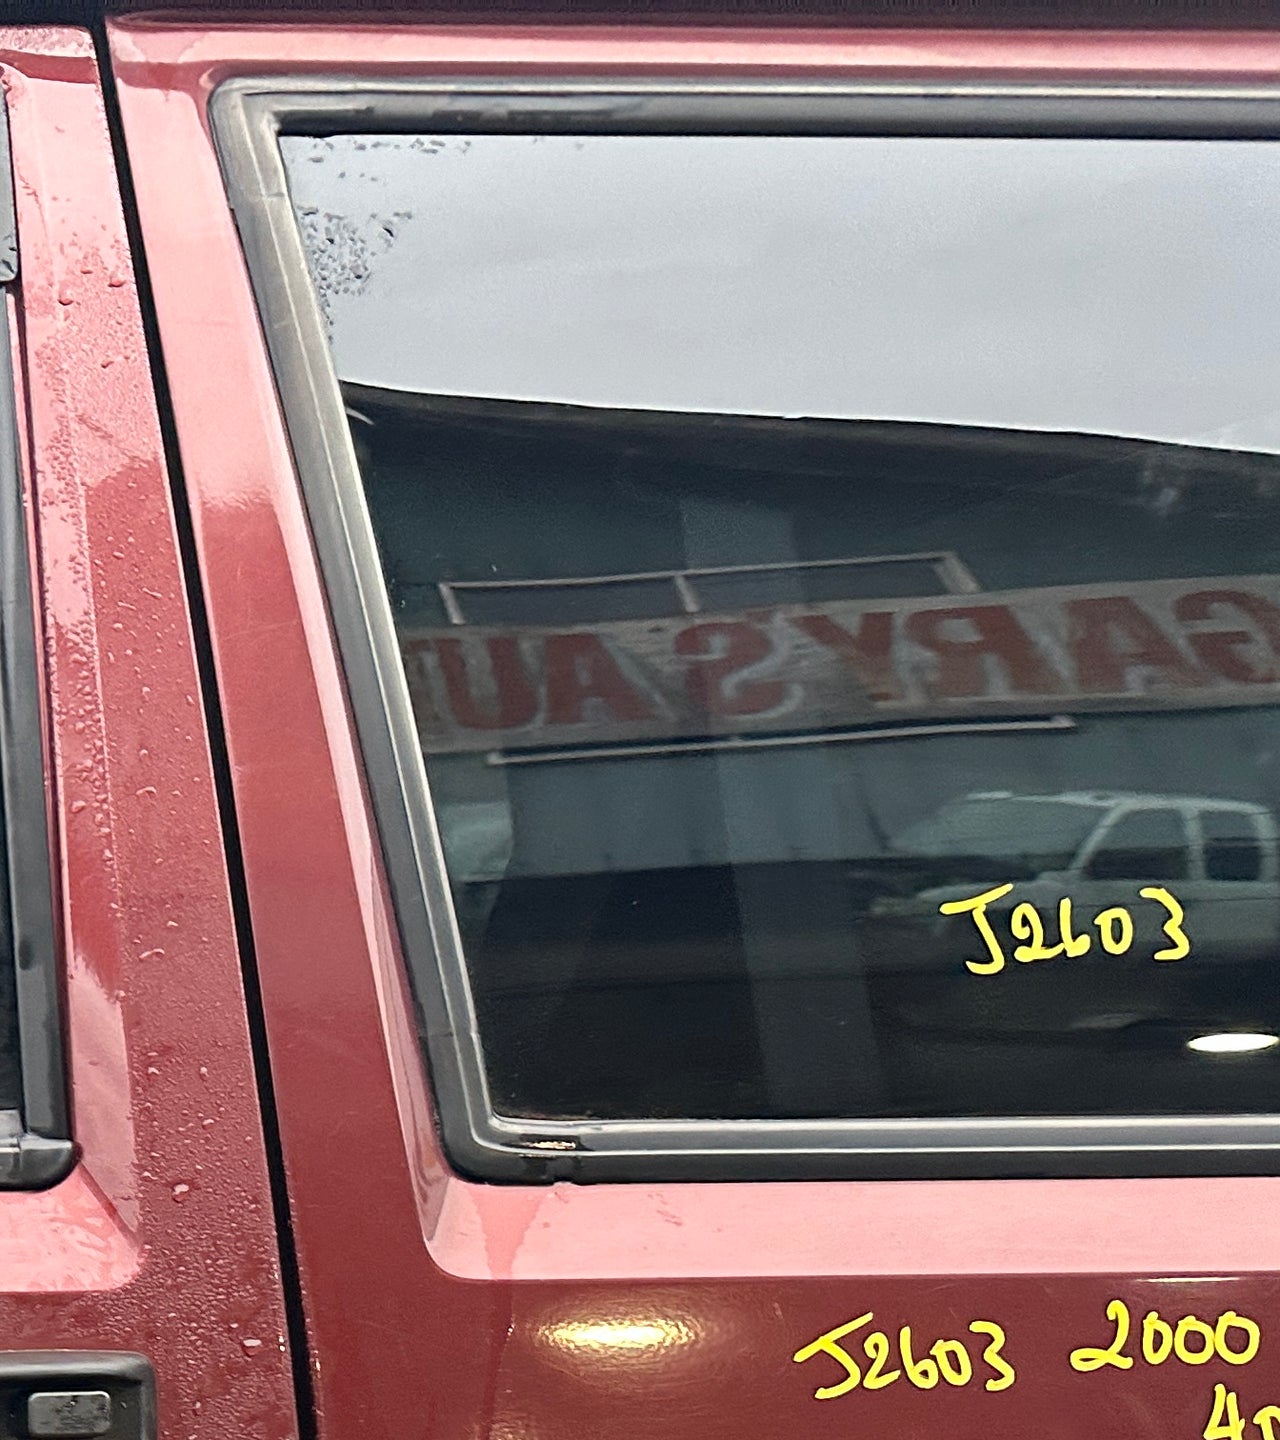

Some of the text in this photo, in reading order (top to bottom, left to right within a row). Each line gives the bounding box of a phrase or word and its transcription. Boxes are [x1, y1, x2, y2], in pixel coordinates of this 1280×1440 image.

[940, 884, 1191, 975] J2603
[793, 1299, 1261, 1400] J2603 2000
